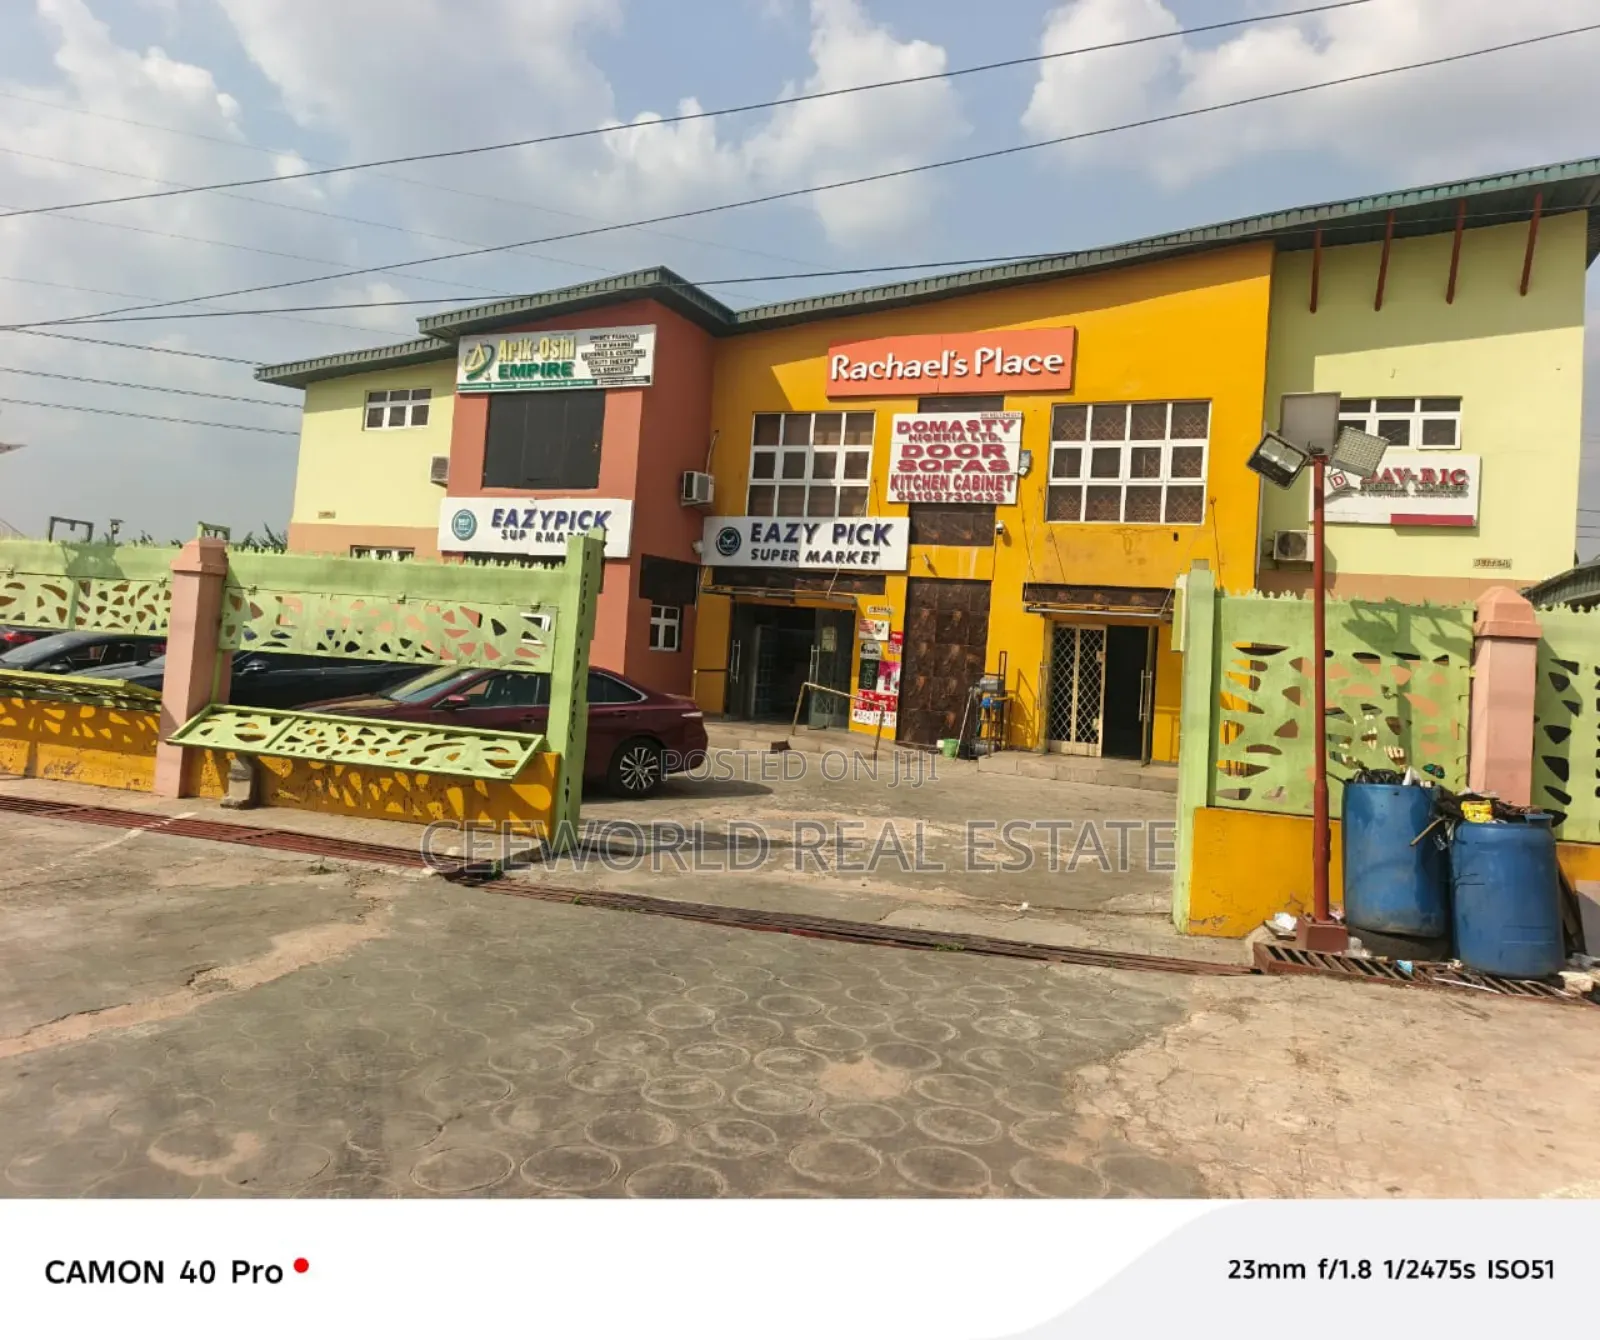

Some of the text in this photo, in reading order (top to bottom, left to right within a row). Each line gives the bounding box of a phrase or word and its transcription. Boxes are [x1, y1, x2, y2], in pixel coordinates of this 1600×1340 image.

[498, 361, 575, 379] EMPIRE
[831, 347, 1063, 380] Rachael's Place
[897, 420, 1016, 434] DOMASTY
[909, 433, 966, 442] NIGERIA
[901, 444, 1006, 459] DOOR
[897, 459, 1010, 473] SOFAS
[890, 474, 1015, 492] KITCHEN CABINET
[491, 508, 611, 531] EAZYPICK
[751, 523, 893, 546] EAZY PICK
[751, 548, 880, 565] SUPER MARKET
